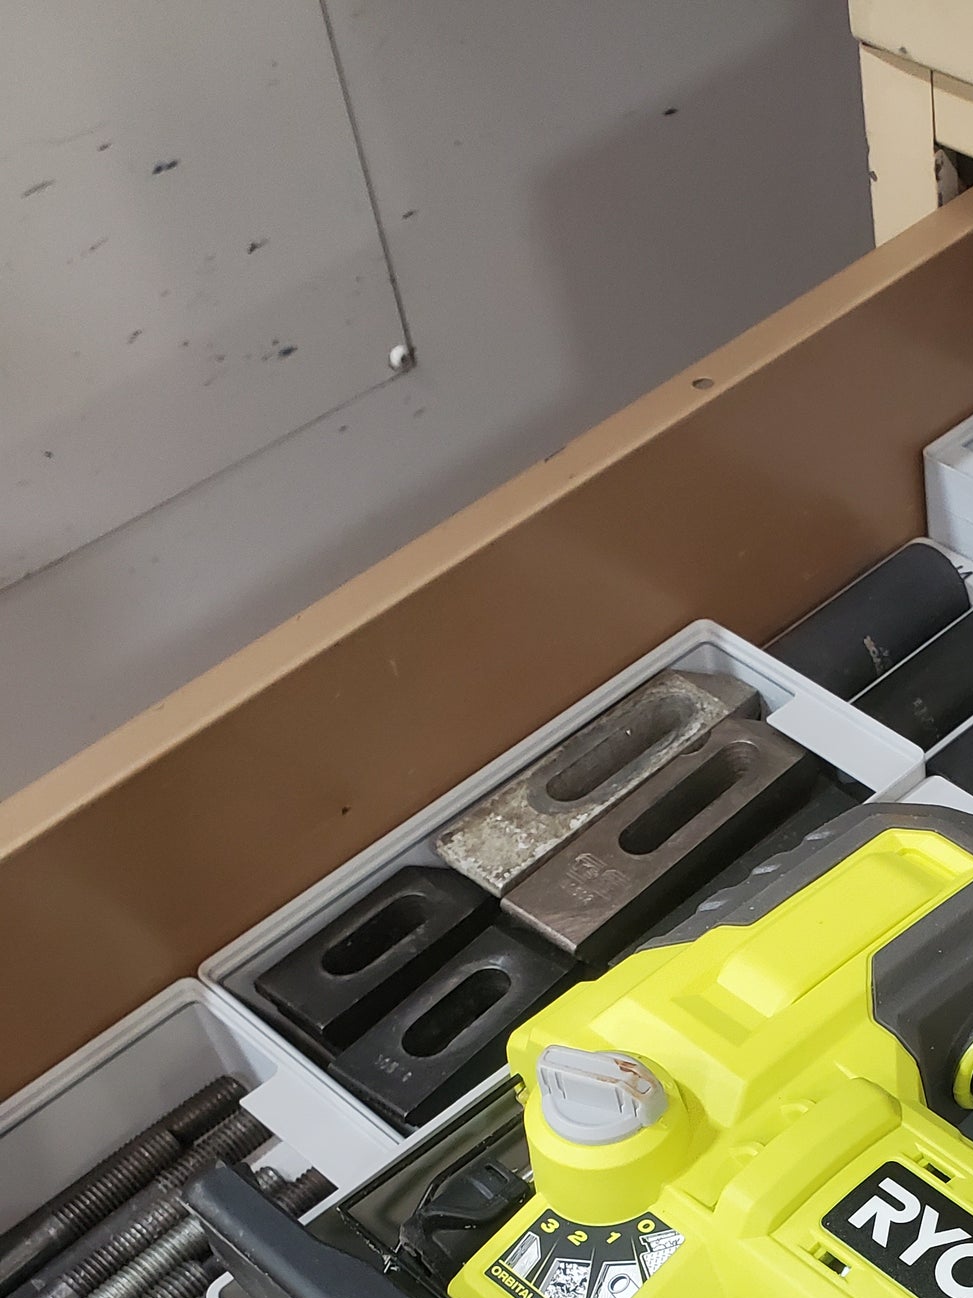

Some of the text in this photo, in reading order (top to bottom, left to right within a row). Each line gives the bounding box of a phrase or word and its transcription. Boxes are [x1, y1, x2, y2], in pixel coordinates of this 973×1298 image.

[541, 1218, 656, 1246] 3 2 1 0
